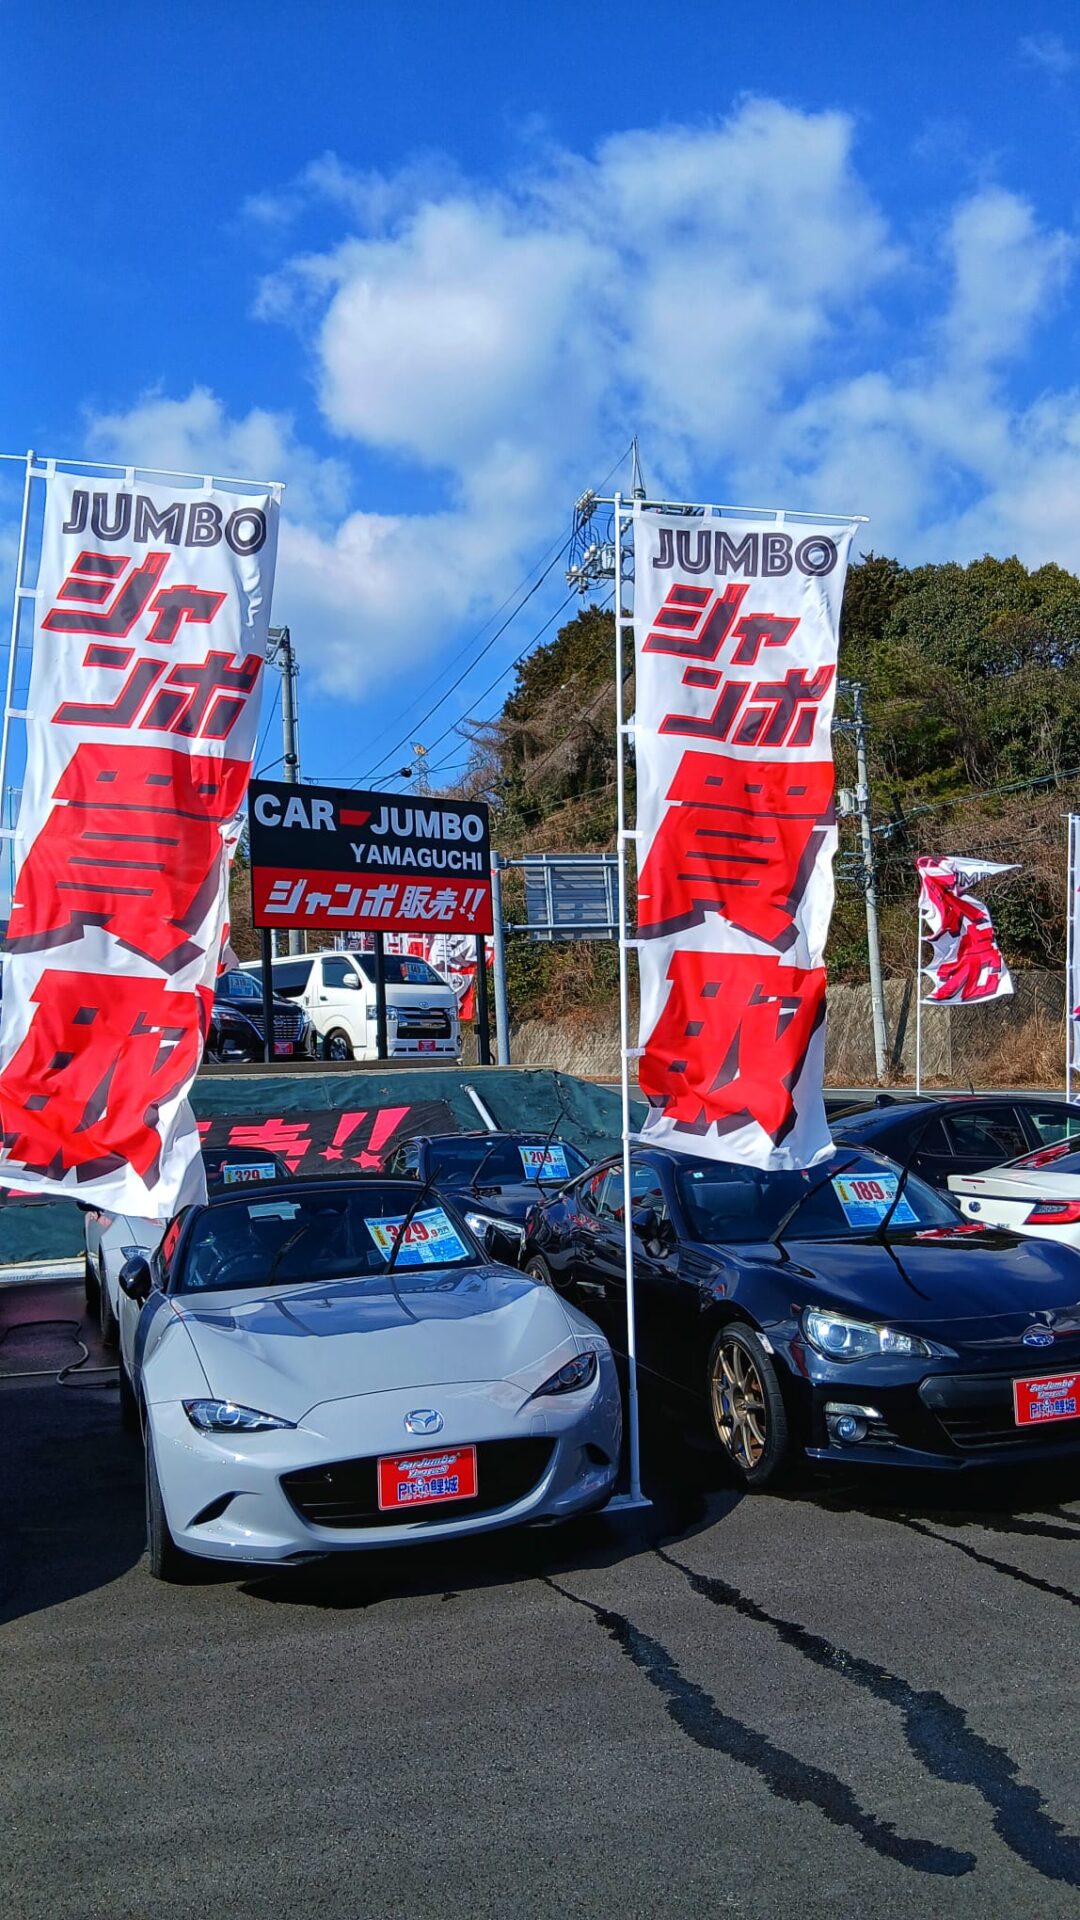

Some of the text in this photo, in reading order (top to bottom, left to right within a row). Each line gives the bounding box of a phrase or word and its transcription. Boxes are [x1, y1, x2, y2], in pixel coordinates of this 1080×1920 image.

[62, 489, 267, 556] JUMBO
[653, 528, 838, 577] JUMBO
[254, 793, 484, 842] CAR JUMBO
[350, 842, 482, 871] YAMAGUCHI
